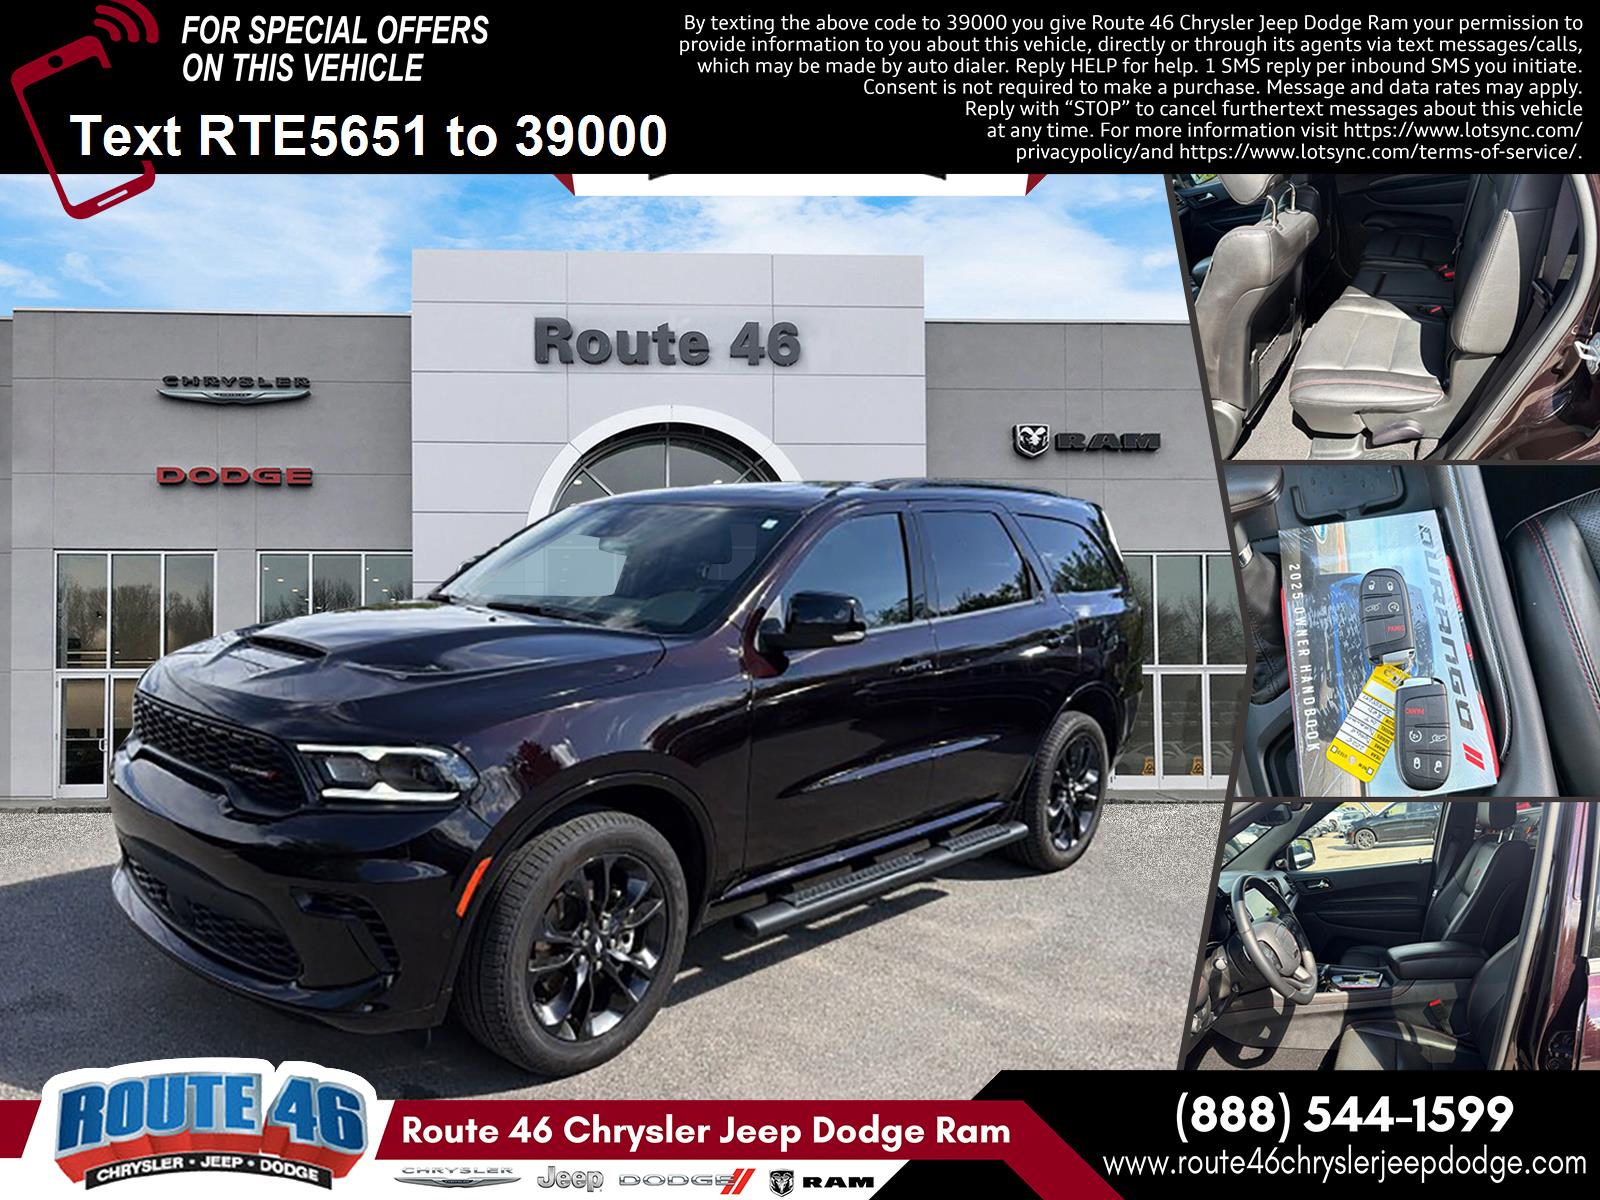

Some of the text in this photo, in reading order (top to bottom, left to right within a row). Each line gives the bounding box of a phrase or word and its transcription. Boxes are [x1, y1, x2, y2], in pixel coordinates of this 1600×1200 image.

[534, 317, 801, 367] Route 46
[162, 375, 311, 388] CHRYSLER
[1055, 432, 1161, 451] RAM
[156, 466, 313, 486] DODGE
[1418, 524, 1474, 731] DURANGO
[1289, 564, 1321, 753] 2025 OWNER HANDBOOK
